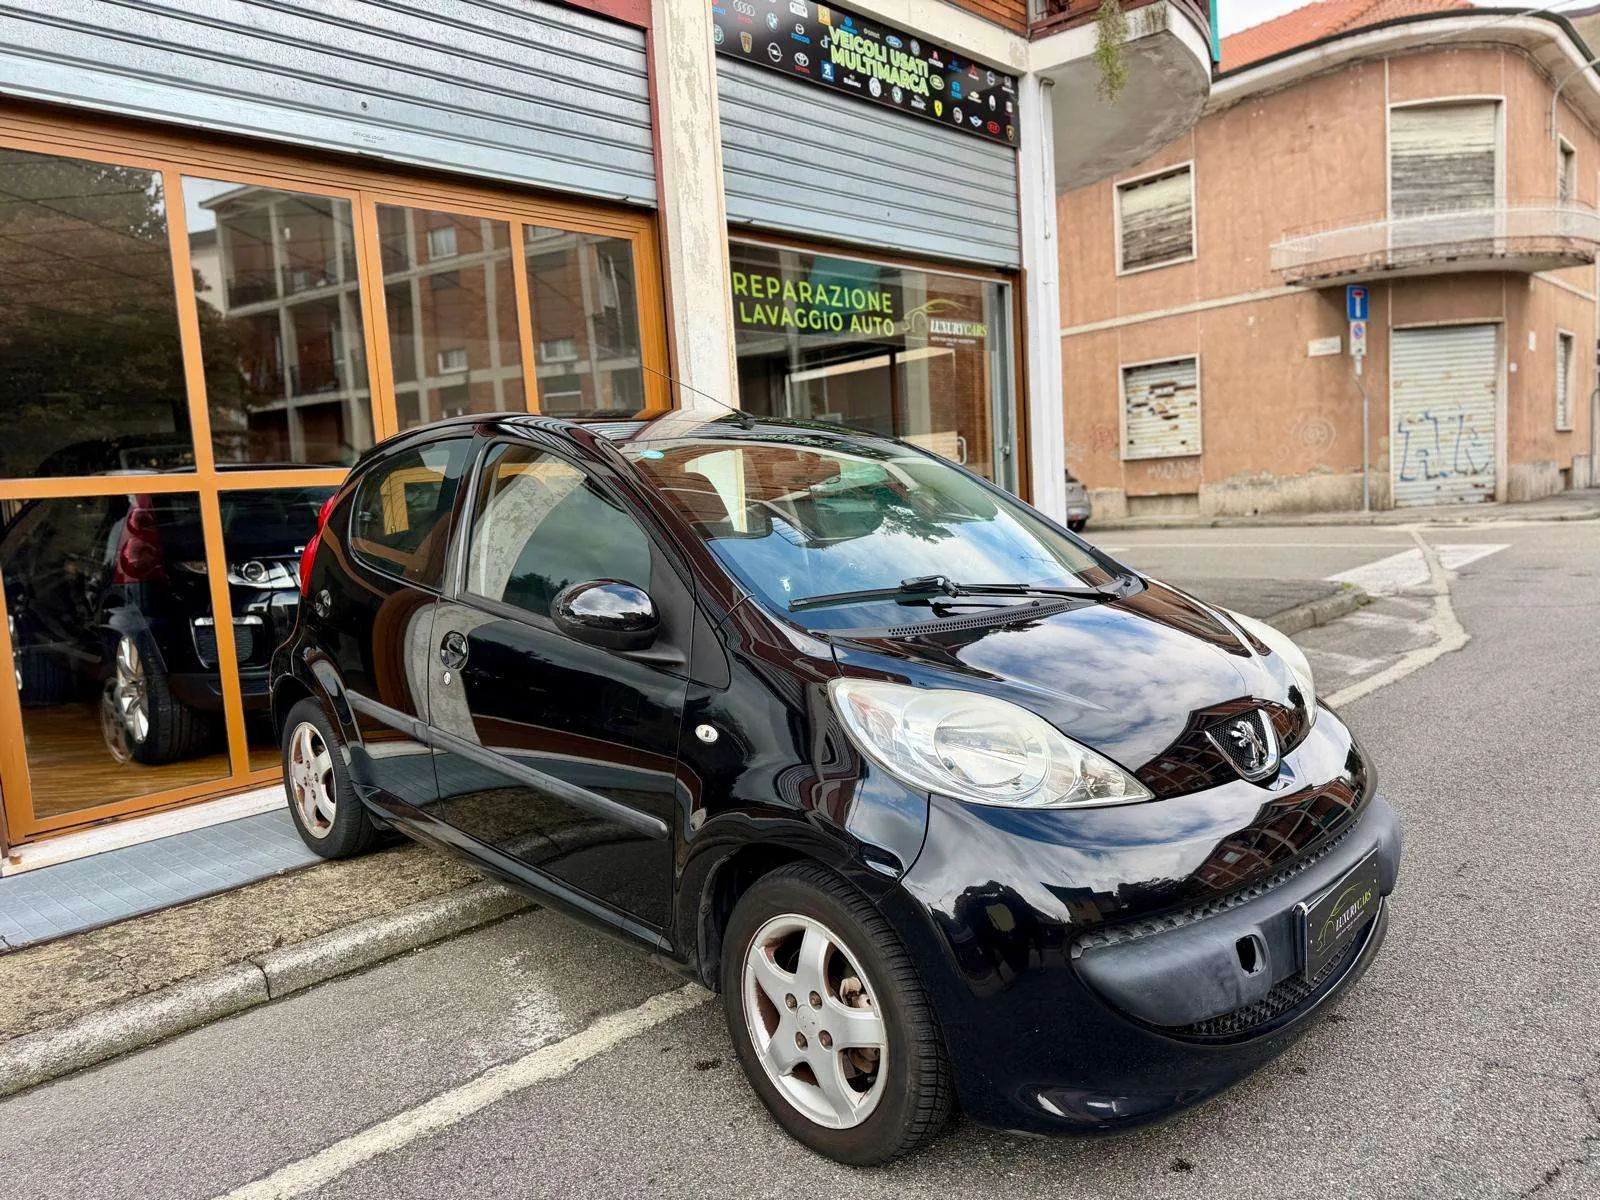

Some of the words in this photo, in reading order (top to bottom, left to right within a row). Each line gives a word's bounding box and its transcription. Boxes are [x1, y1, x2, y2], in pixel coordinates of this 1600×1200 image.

[828, 25, 887, 63] VEICOLI
[890, 48, 929, 78] USATI
[831, 45, 929, 97] MULTIMARCA
[732, 272, 893, 313] REPARAZIONE
[739, 302, 843, 332] LAVAGGIO
[850, 314, 895, 337] AUTO
